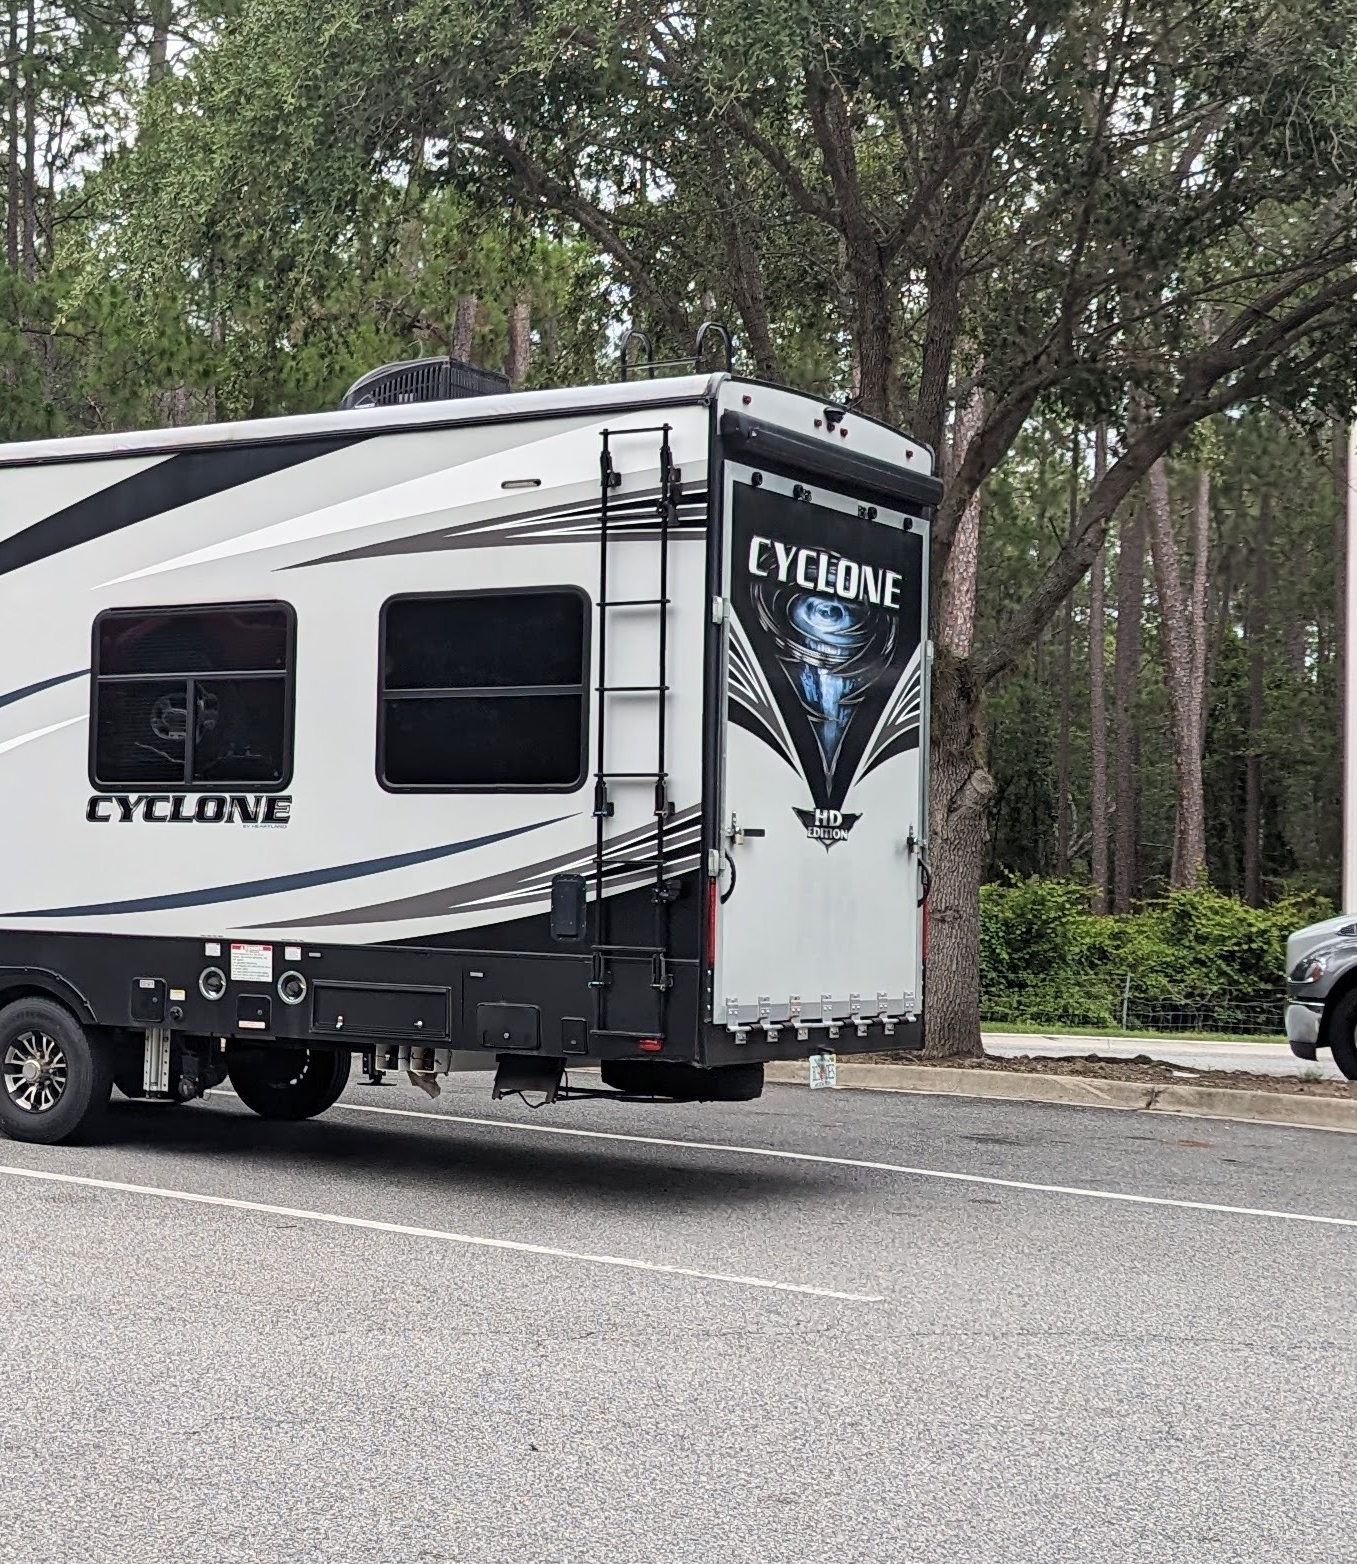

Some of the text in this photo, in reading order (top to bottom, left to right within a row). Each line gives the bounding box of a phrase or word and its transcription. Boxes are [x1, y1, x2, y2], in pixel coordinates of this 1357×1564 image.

[748, 534, 903, 609] CYCLONE
[85, 794, 293, 824] CYCLONE
[814, 808, 843, 827] HD
[807, 827, 849, 840] EDITION
